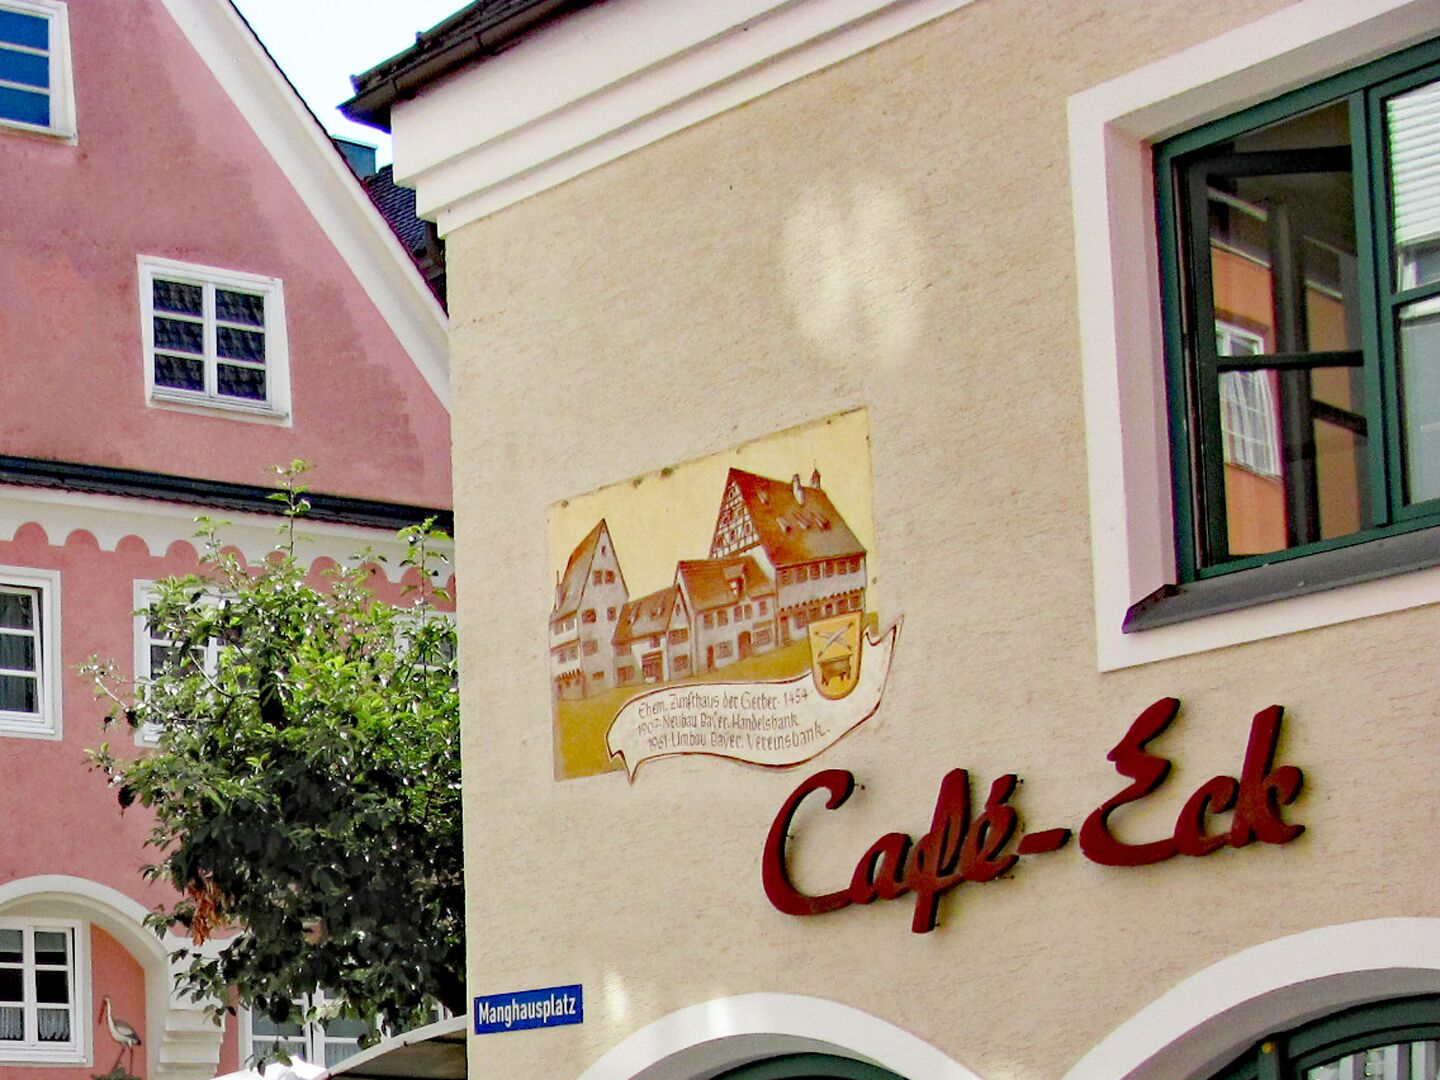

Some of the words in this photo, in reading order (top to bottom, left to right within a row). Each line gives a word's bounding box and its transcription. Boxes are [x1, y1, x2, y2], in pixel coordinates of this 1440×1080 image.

[722, 691, 738, 709] der
[732, 712, 799, 731] Handelsbank
[762, 697, 1305, 934] Café-Eck
[478, 993, 577, 1028] Manghausplatz
